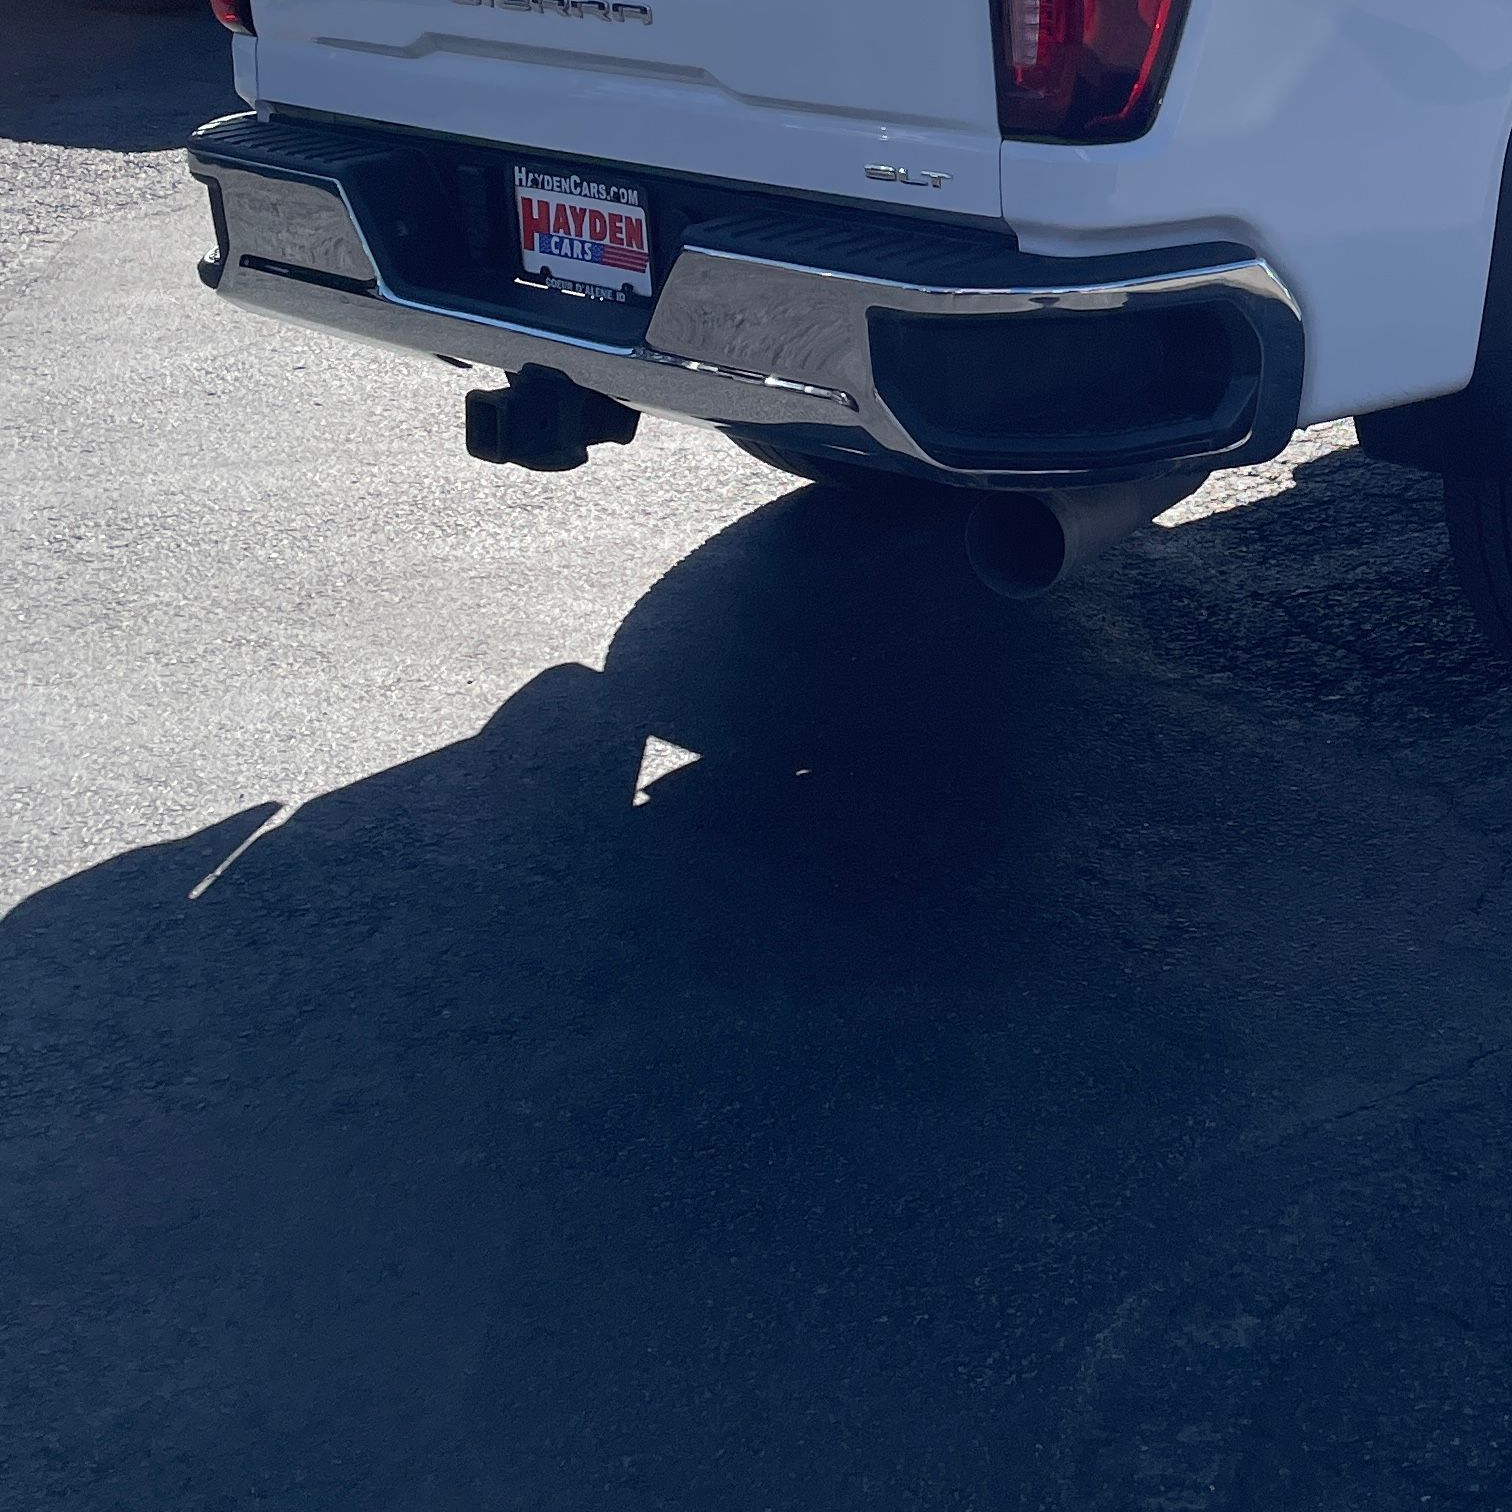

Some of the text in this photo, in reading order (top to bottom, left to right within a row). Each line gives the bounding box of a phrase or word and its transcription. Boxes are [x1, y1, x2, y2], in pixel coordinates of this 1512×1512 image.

[864, 164, 953, 189] SLT
[520, 196, 645, 252] HAYDEN
[551, 237, 593, 261] CARS
